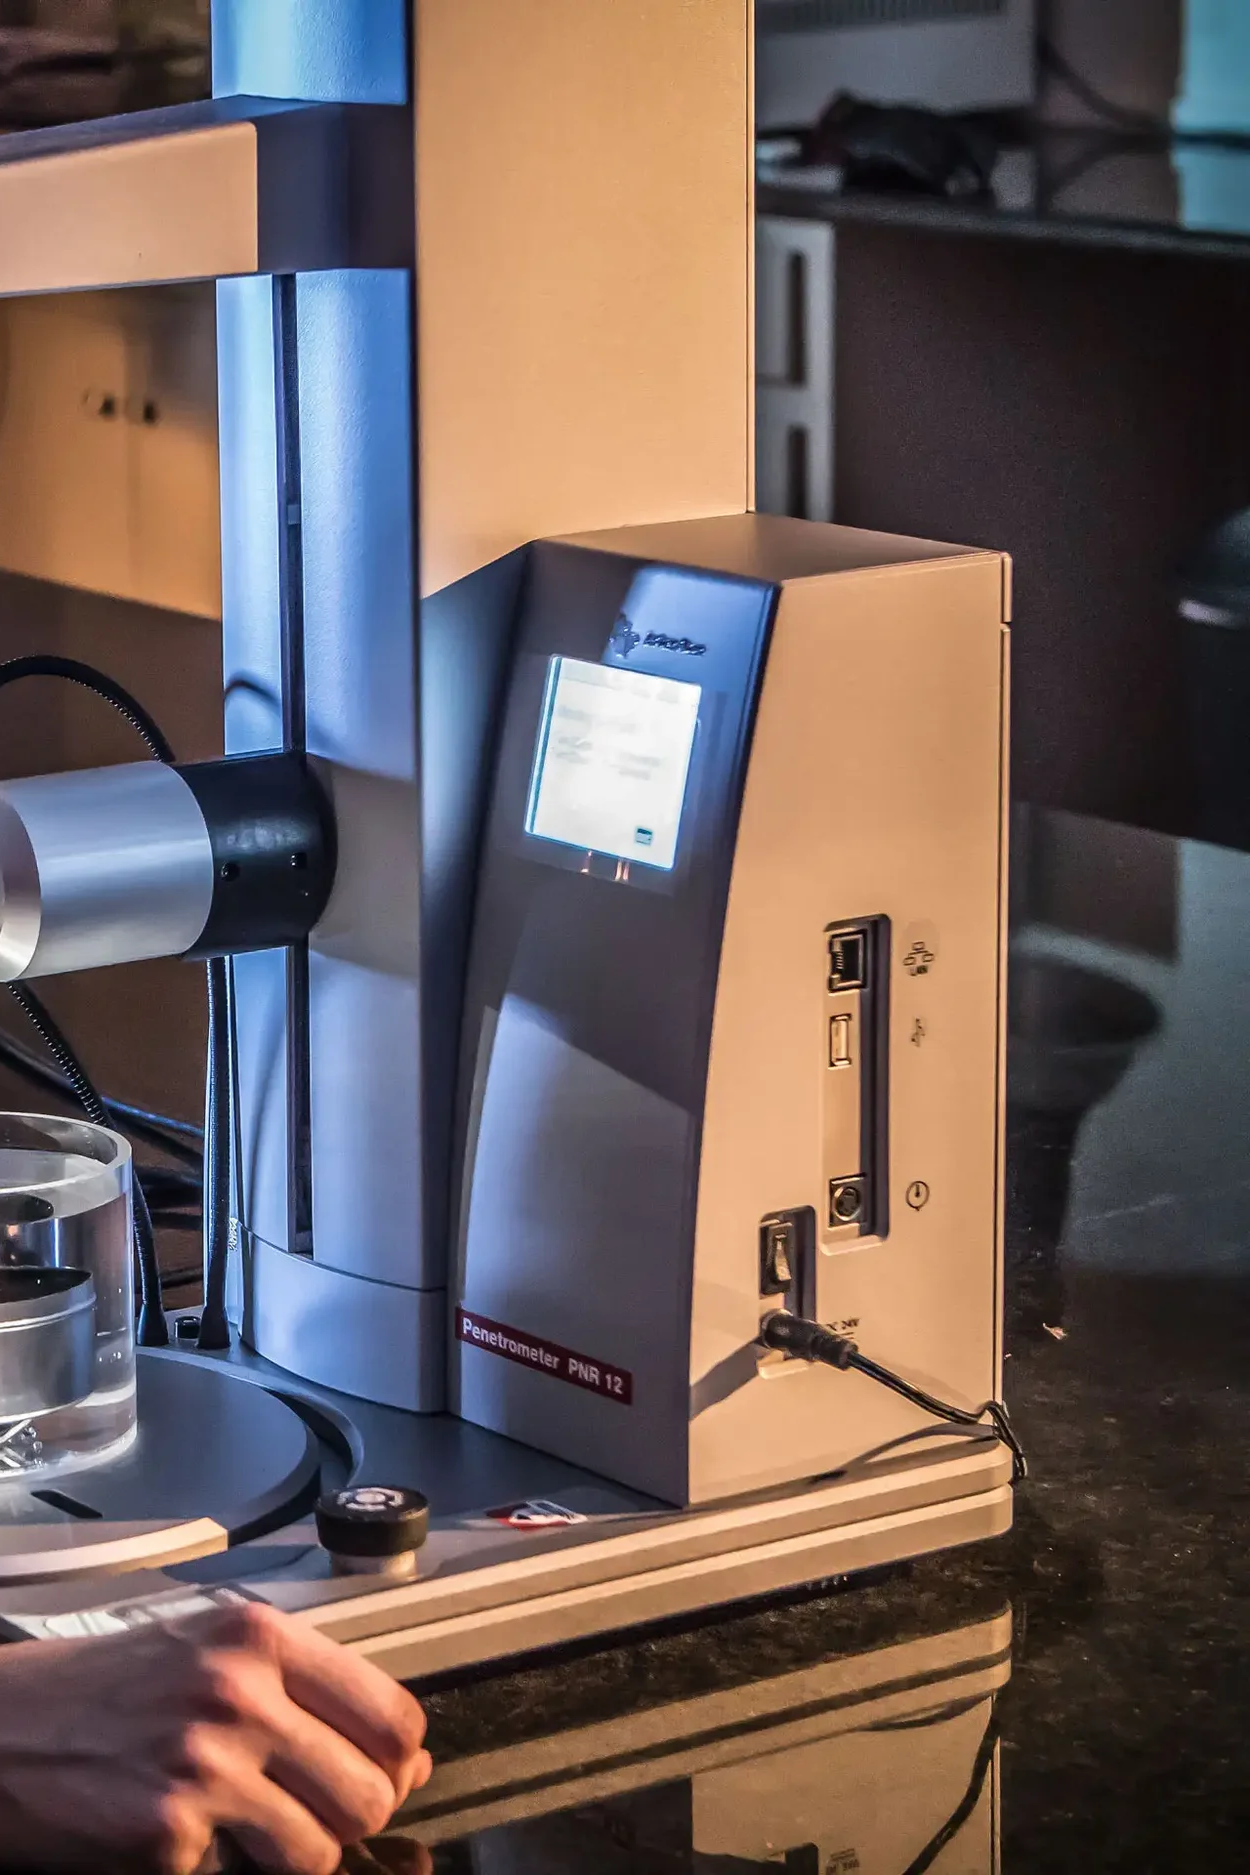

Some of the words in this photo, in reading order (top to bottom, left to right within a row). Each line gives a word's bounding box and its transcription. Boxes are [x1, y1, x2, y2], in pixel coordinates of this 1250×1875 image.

[462, 1317, 561, 1370] Penetrometer
[568, 1357, 600, 1386] PNR
[605, 1373, 623, 1395] 12
